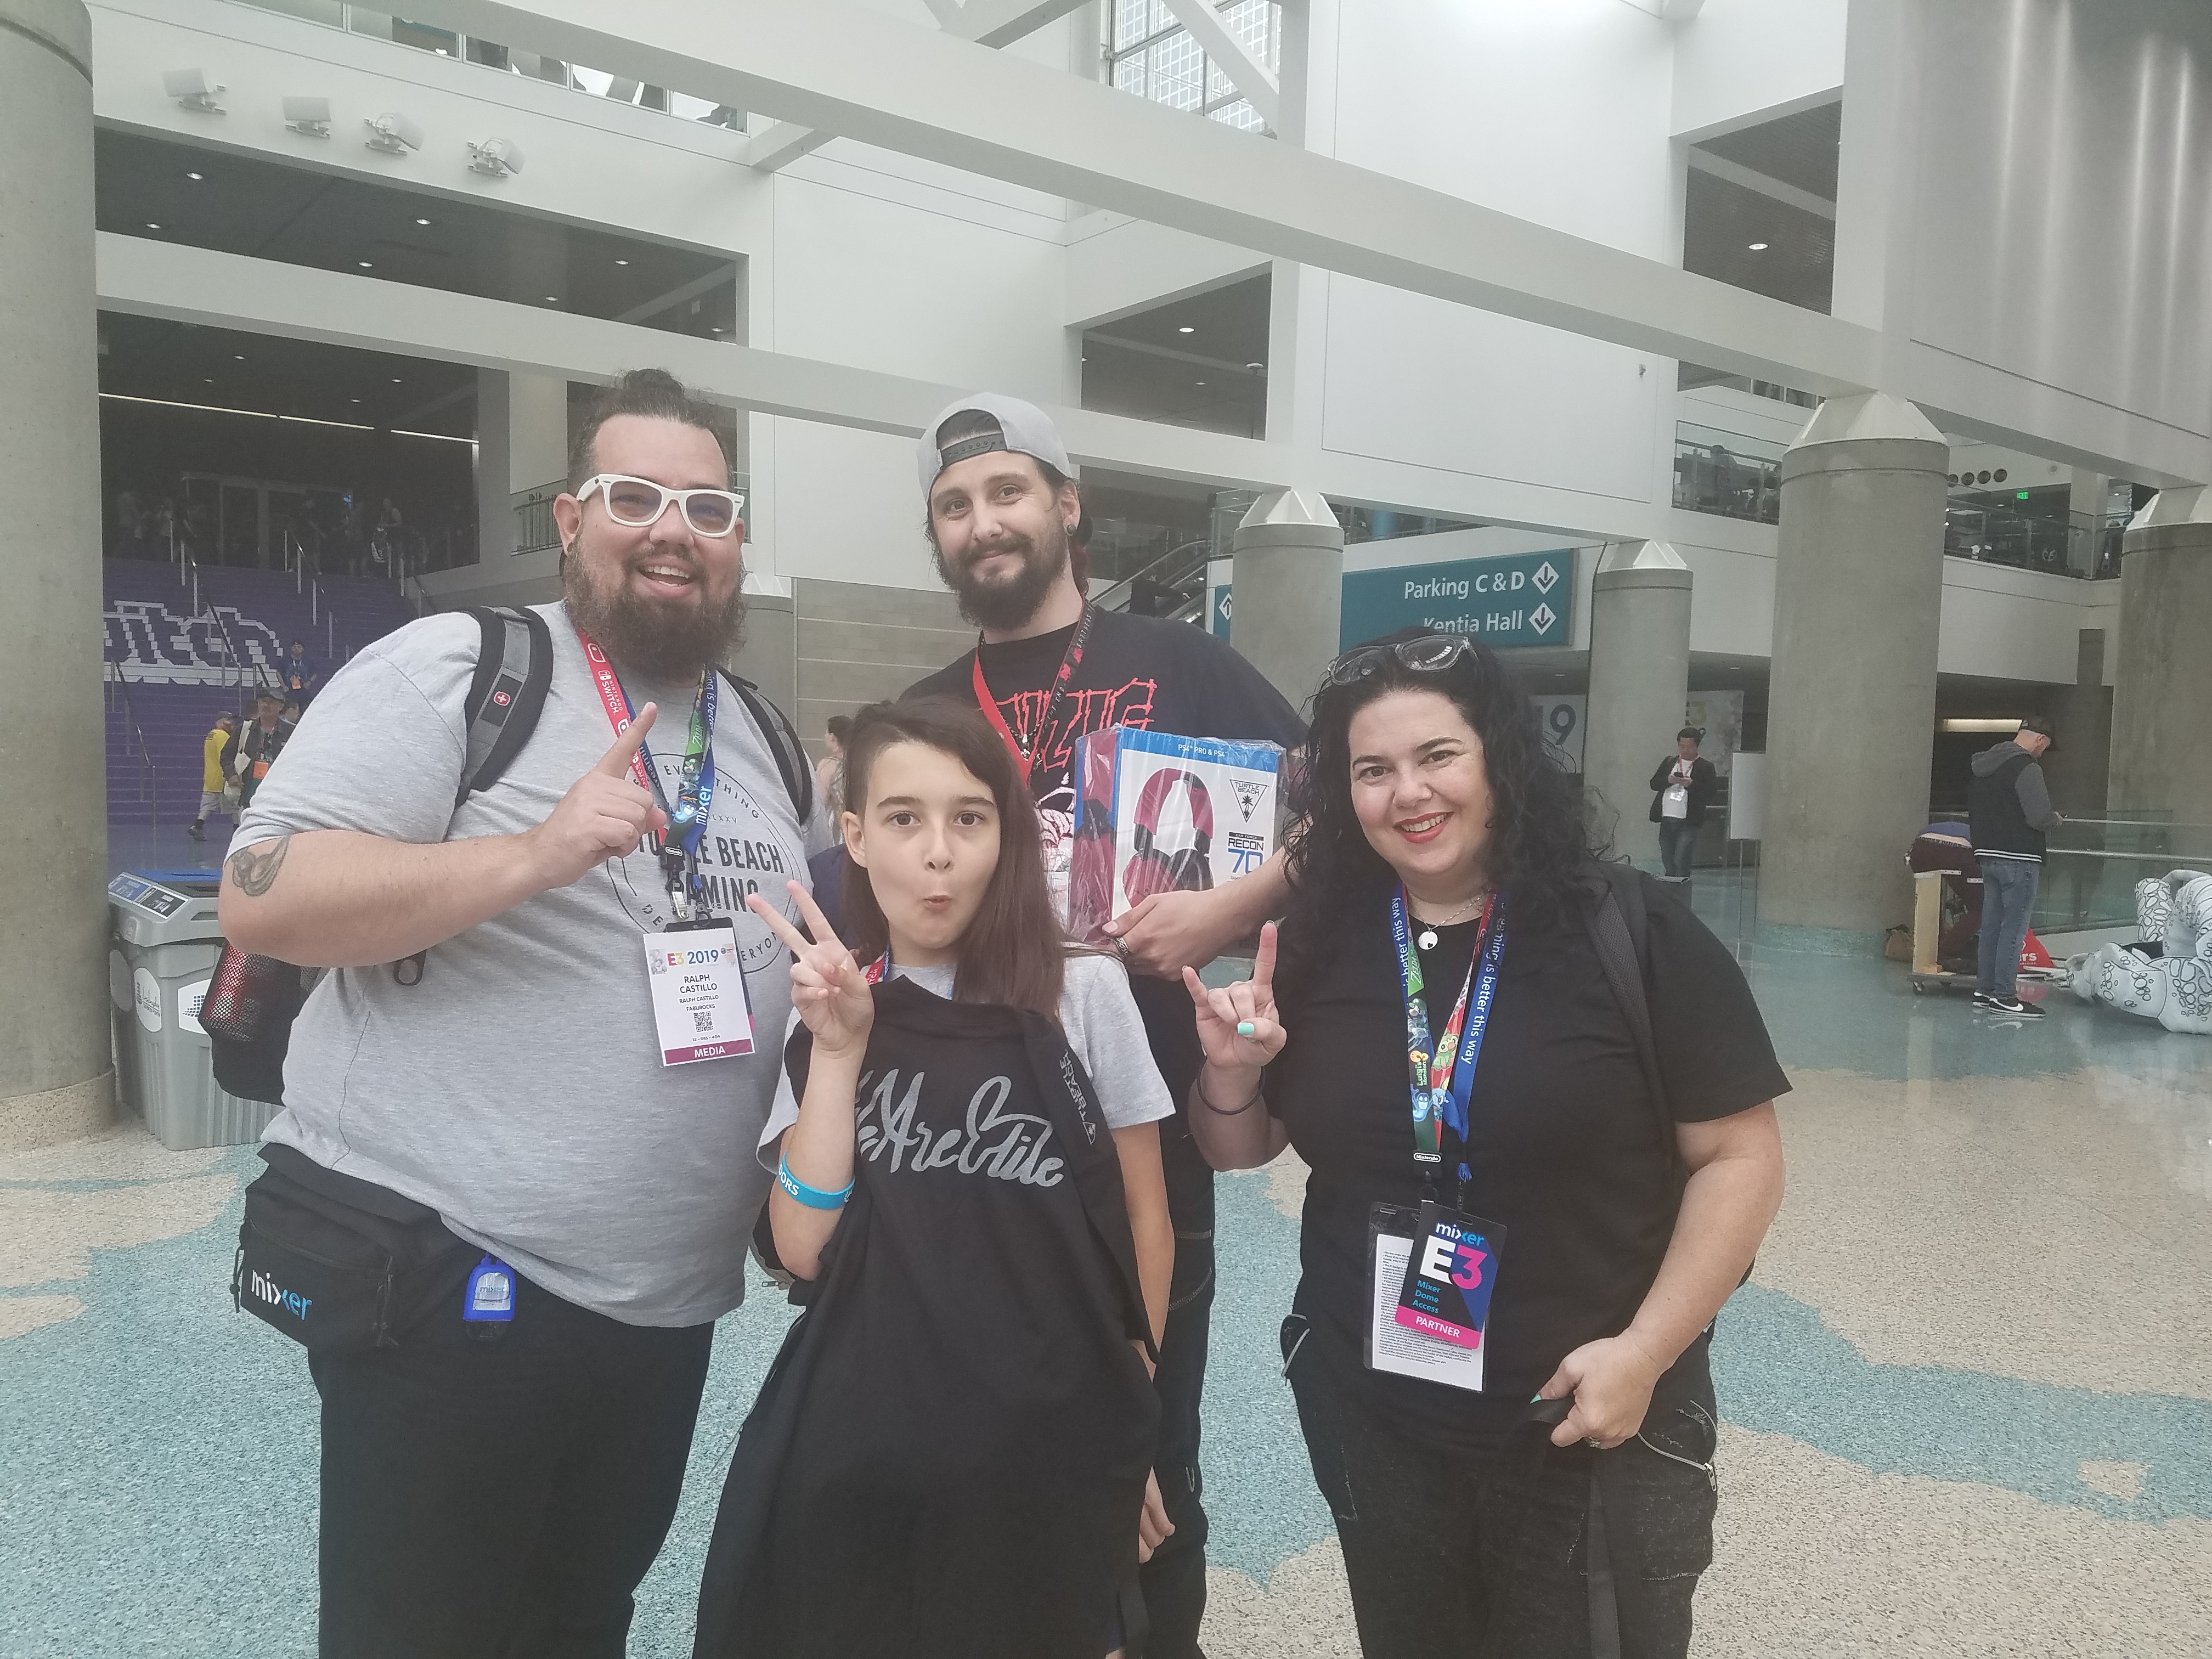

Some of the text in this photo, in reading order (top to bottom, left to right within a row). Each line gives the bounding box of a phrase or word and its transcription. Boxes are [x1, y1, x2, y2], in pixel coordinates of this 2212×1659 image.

[1404, 571, 1525, 600] Parking C & D
[1486, 610, 1523, 631] Hall
[602, 681, 619, 713] SWITCH
[610, 680, 623, 711] NINTENDO
[1194, 747, 1207, 755] PRO
[1235, 782, 1260, 791] TURTLE
[1238, 787, 1260, 796] BEACH
[696, 786, 712, 826] mixer
[715, 836, 785, 874] BEACH
[1228, 838, 1264, 851] RECON
[1228, 848, 1263, 874] 70
[1392, 898, 1401, 919] way
[1393, 919, 1405, 941] this
[667, 952, 685, 966] E3
[687, 949, 719, 964] 2019
[680, 983, 718, 994] CASTILLO
[684, 974, 710, 984] RALPH
[1477, 976, 1496, 1013] better
[1470, 1015, 1486, 1037] this
[694, 1046, 726, 1058] MEDIA
[1461, 1040, 1477, 1065] way
[1435, 1222, 1484, 1247] mixer
[1420, 1234, 1488, 1290] E3
[251, 1269, 313, 1321] mixer
[1415, 1289, 1439, 1303] Dome
[1417, 1279, 1441, 1293] Mixer
[1412, 1299, 1439, 1313] Access
[1415, 1316, 1460, 1338] PARTNER
